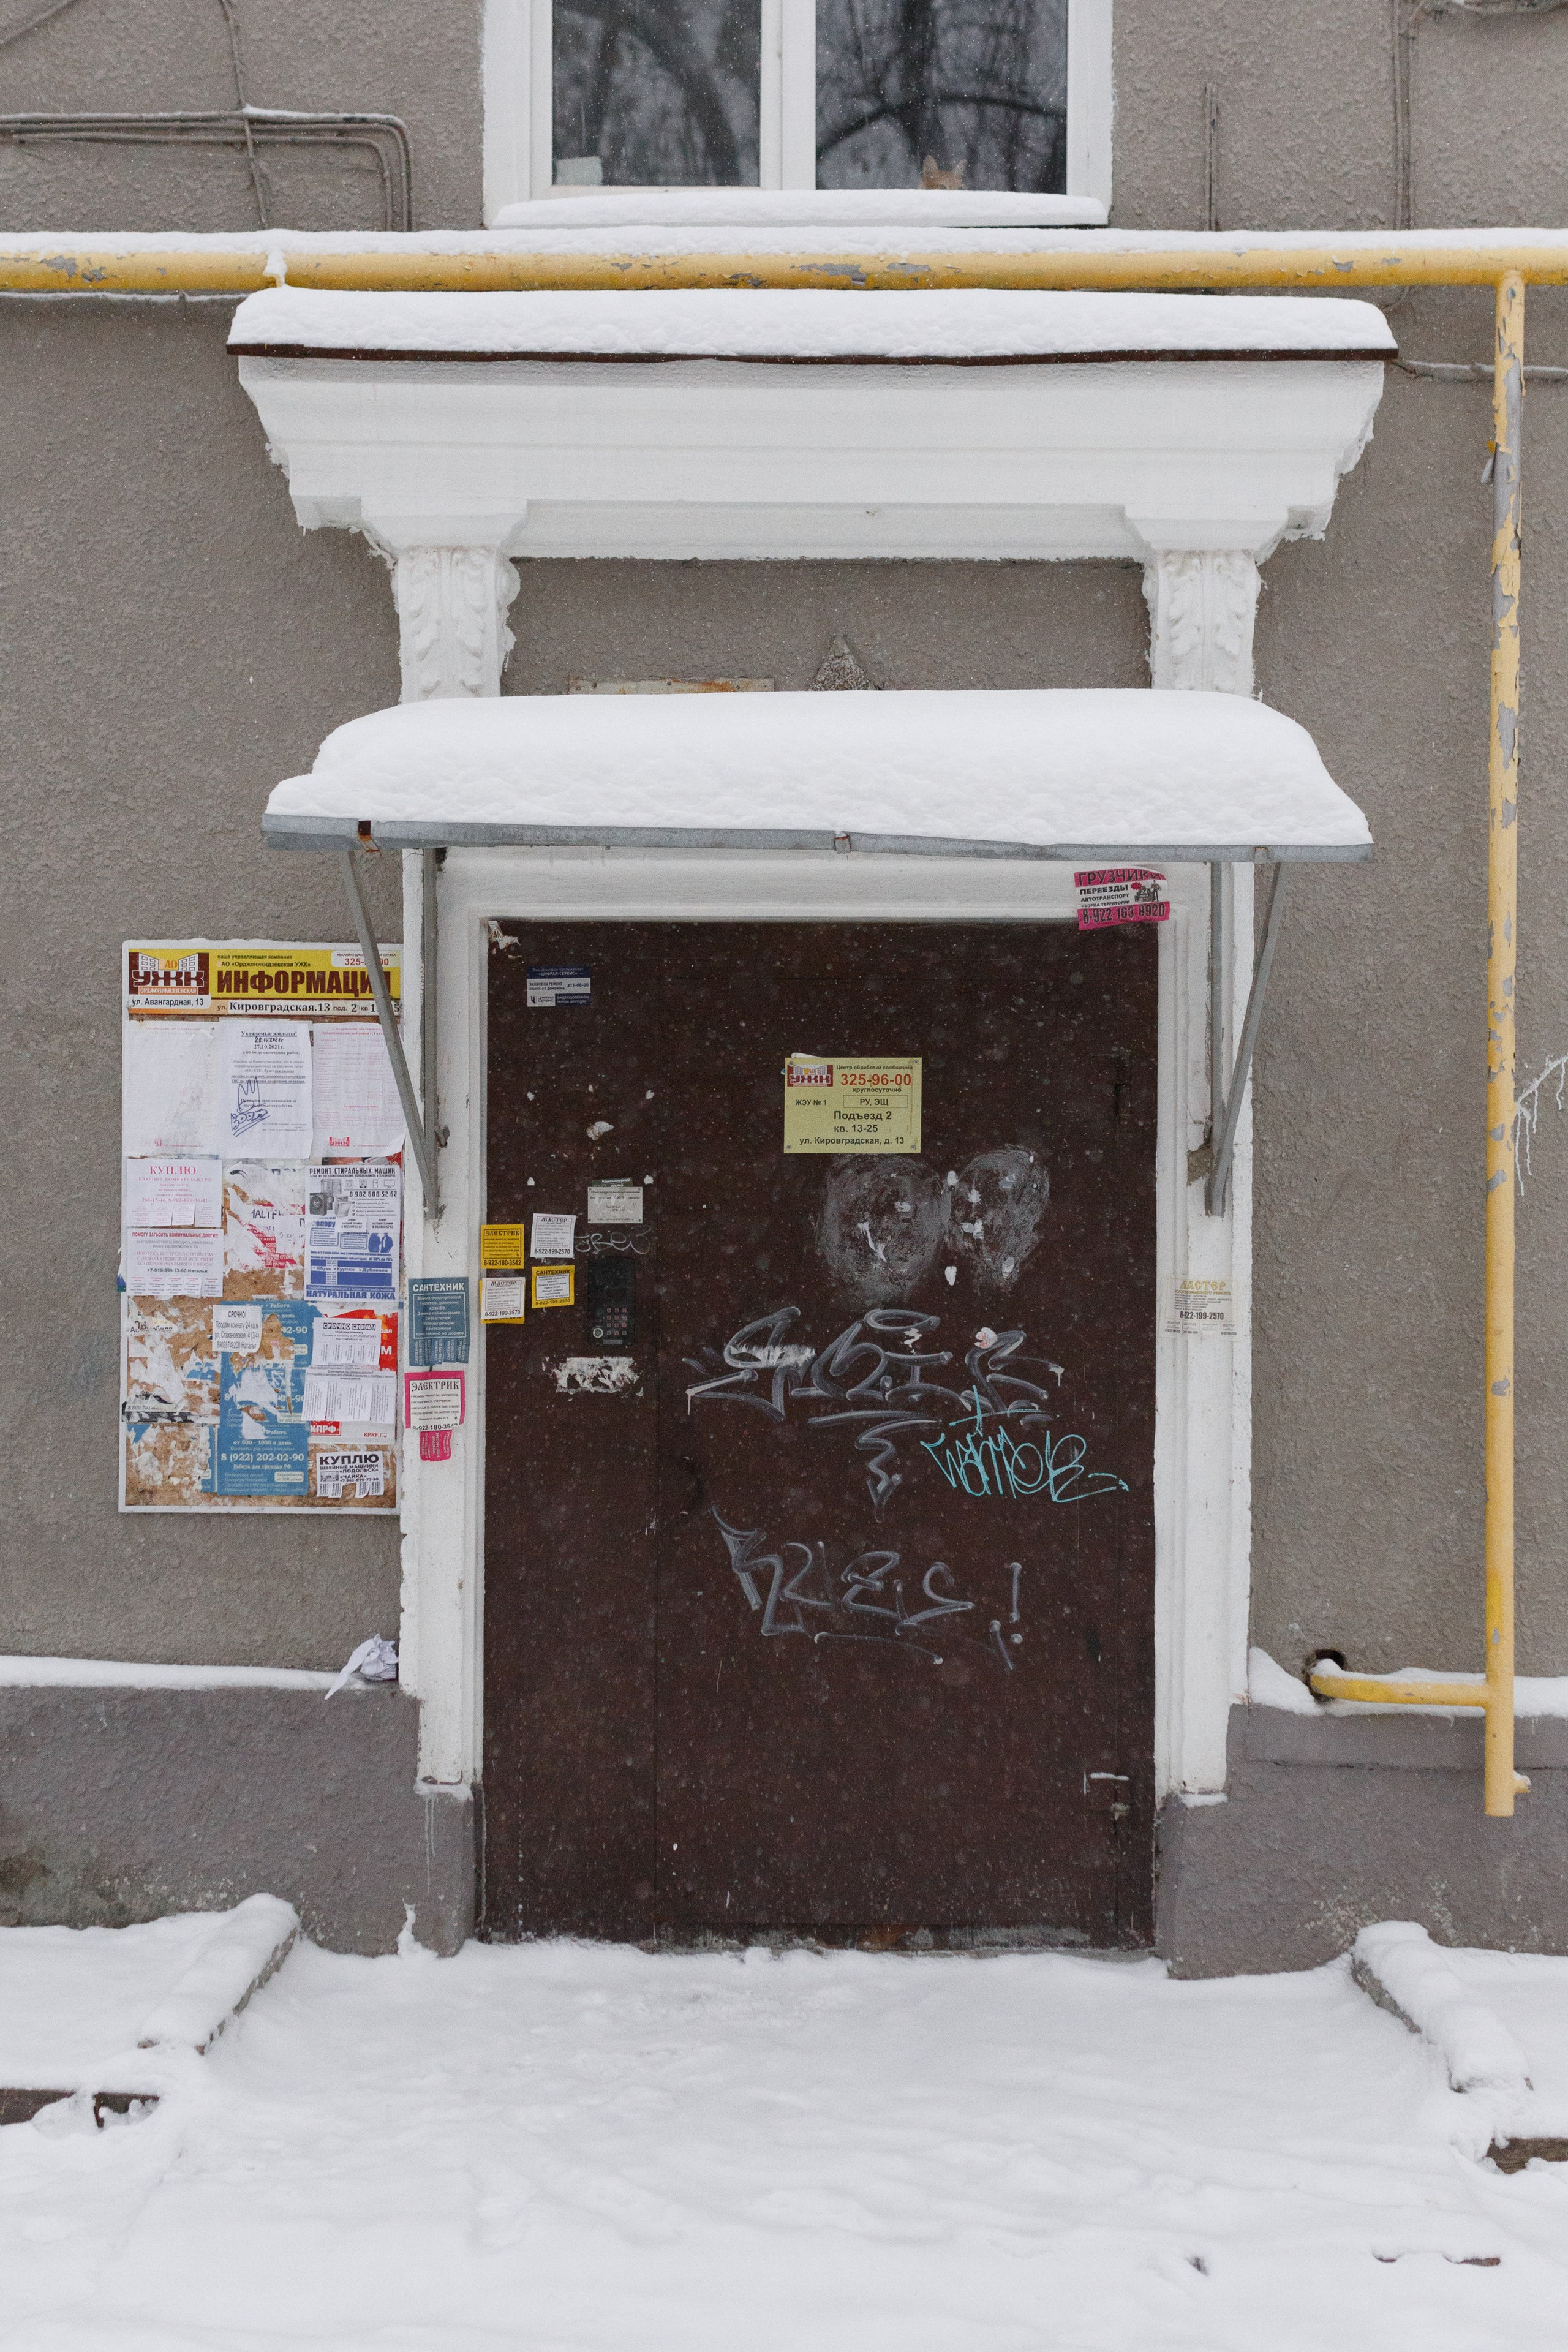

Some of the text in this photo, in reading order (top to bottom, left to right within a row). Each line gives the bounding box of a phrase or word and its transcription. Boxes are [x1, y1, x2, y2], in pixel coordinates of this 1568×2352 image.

[1079, 869, 1161, 886] ГРУЗЧИКИ
[1080, 885, 1128, 895] ПЕРЕЕЗДЫ
[1081, 894, 1129, 902] АВТОТРАНСПОРТ
[132, 970, 205, 987] УЖК
[789, 1074, 831, 1084] УЖК
[840, 1073, 911, 1086] 325-96-00
[834, 1111, 892, 1121] Подъезд 2
[815, 1137, 882, 1145] Кировградская,
[150, 1166, 197, 1175] КУПЛЮ
[413, 1283, 464, 1292] САНТЕХНИК
[306, 1290, 367, 1299] НАТУРАЛЬНАЯ
[412, 1381, 459, 1392] ЭЛЕКТРИК
[311, 1425, 336, 1433] КПРФ
[230, 1453, 253, 1463] (922)
[319, 1454, 379, 1465] КУПЛЮ
